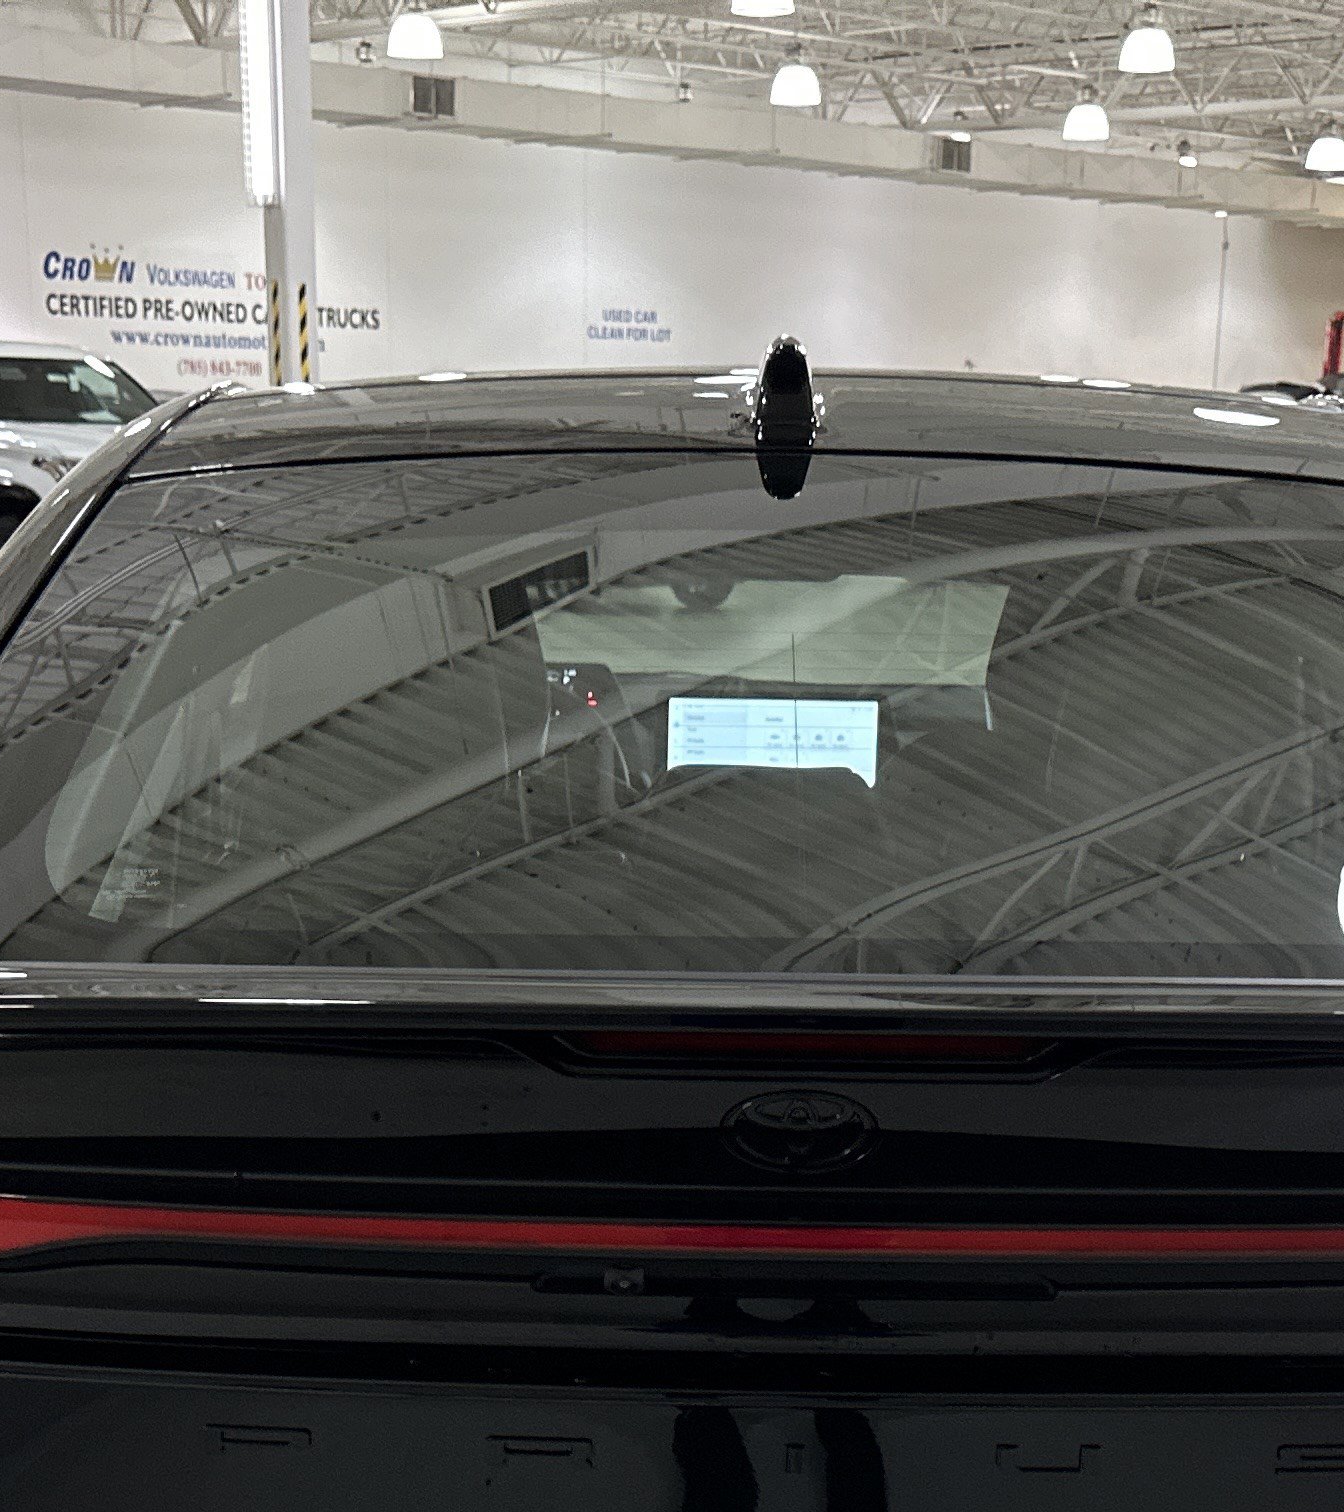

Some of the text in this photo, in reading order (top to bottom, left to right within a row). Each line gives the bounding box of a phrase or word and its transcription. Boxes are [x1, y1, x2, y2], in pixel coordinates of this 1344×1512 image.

[46, 293, 138, 320] CERTIFIED
[142, 298, 248, 324] PRE-OWNED
[317, 306, 380, 330] TRUCKS
